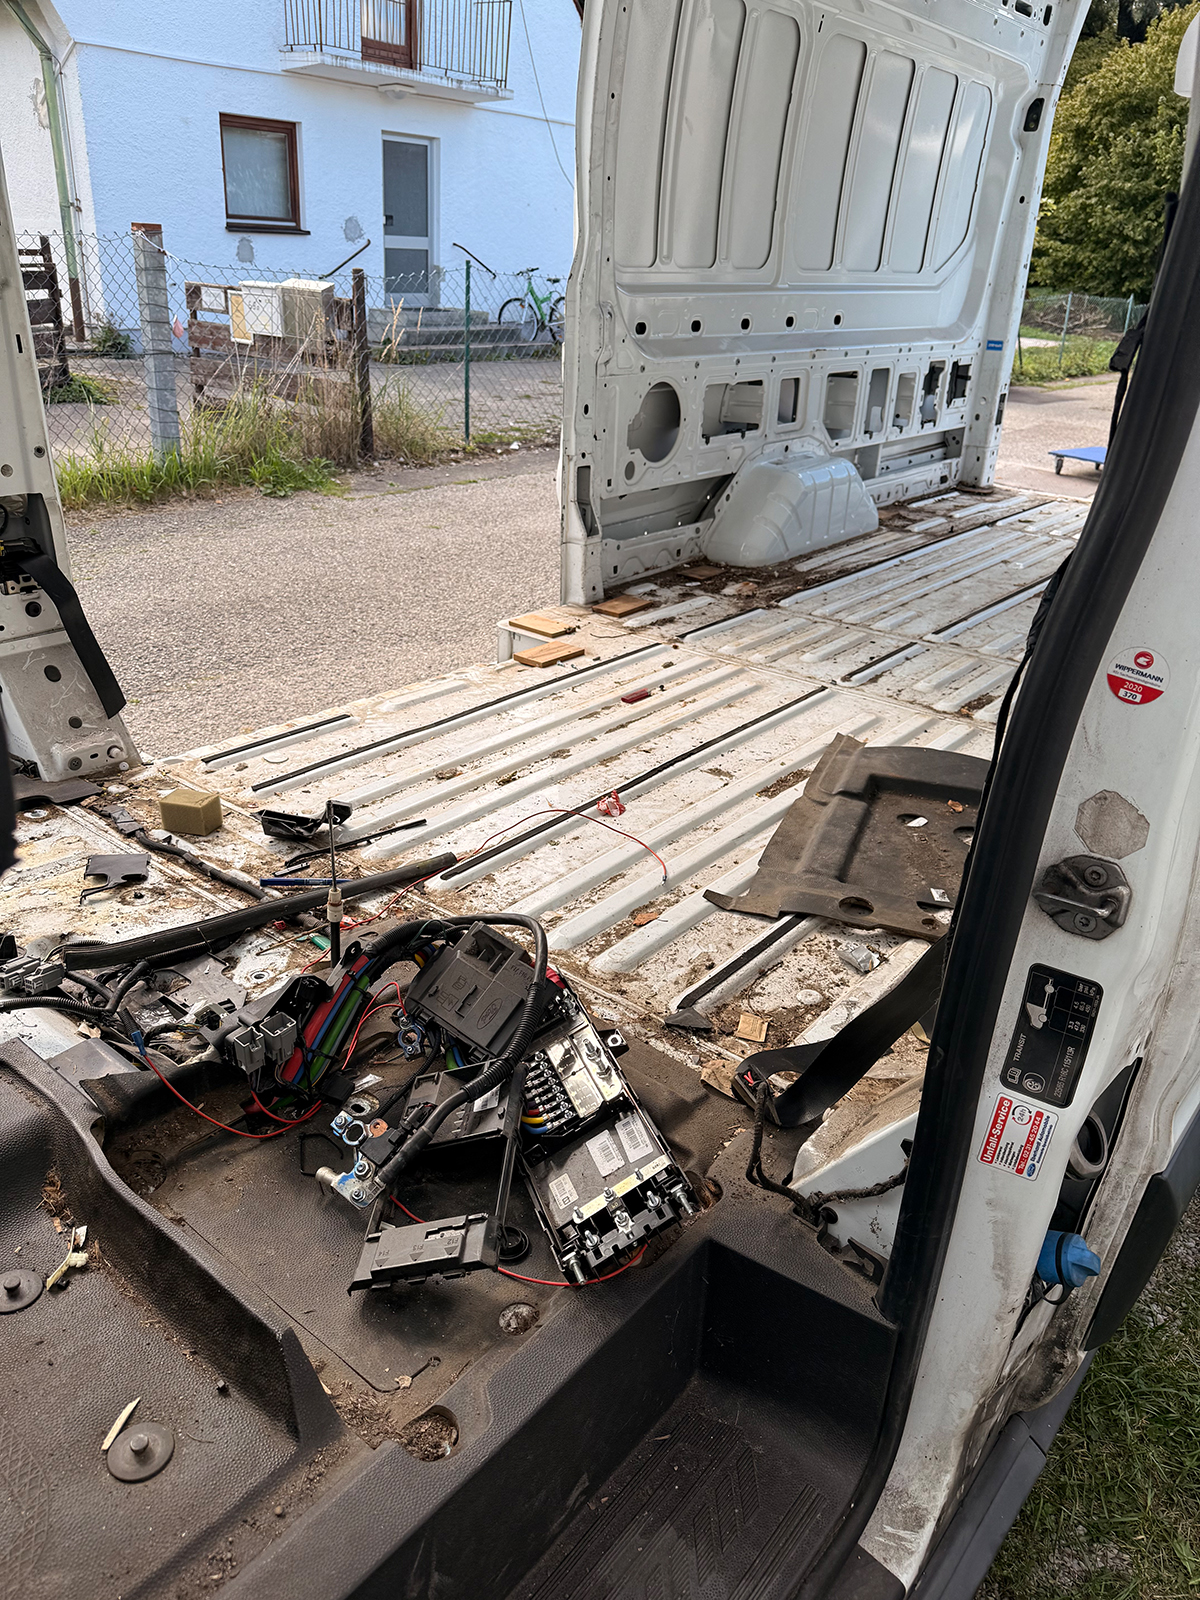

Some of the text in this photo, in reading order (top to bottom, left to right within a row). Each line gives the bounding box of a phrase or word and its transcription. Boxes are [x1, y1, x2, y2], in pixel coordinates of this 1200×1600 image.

[1115, 664, 1164, 682] WIPPERMANN
[1124, 682, 1143, 692] 2020
[1122, 691, 1137, 700] 370
[1013, 1033, 1027, 1062] TRANSIT
[1017, 1108, 1027, 1122] 24h
[983, 1100, 1010, 1161] Unfall-Service
